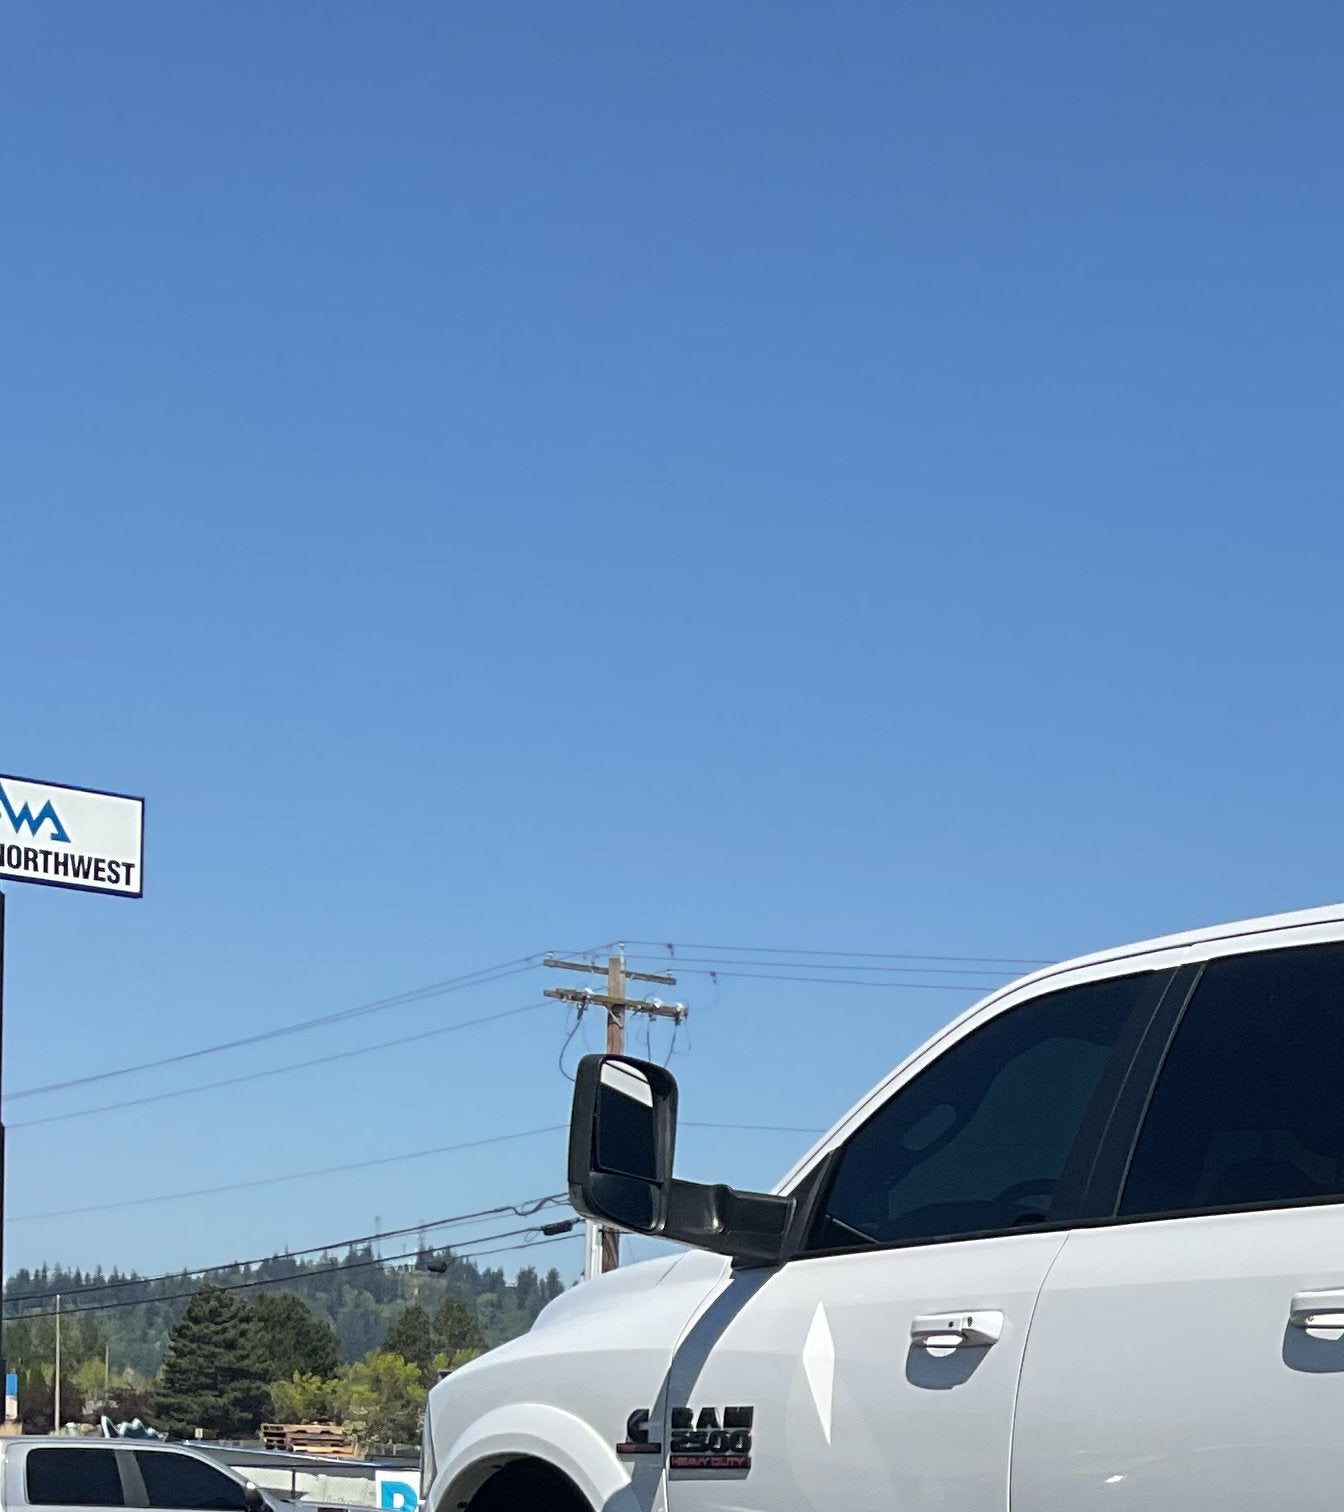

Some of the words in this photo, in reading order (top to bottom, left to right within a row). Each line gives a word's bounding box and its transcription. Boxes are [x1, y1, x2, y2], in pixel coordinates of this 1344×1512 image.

[671, 1406, 755, 1429] RAM
[670, 1429, 752, 1453] 2500
[671, 1456, 710, 1467] HEAVY
[711, 1456, 746, 1467] DUTY
